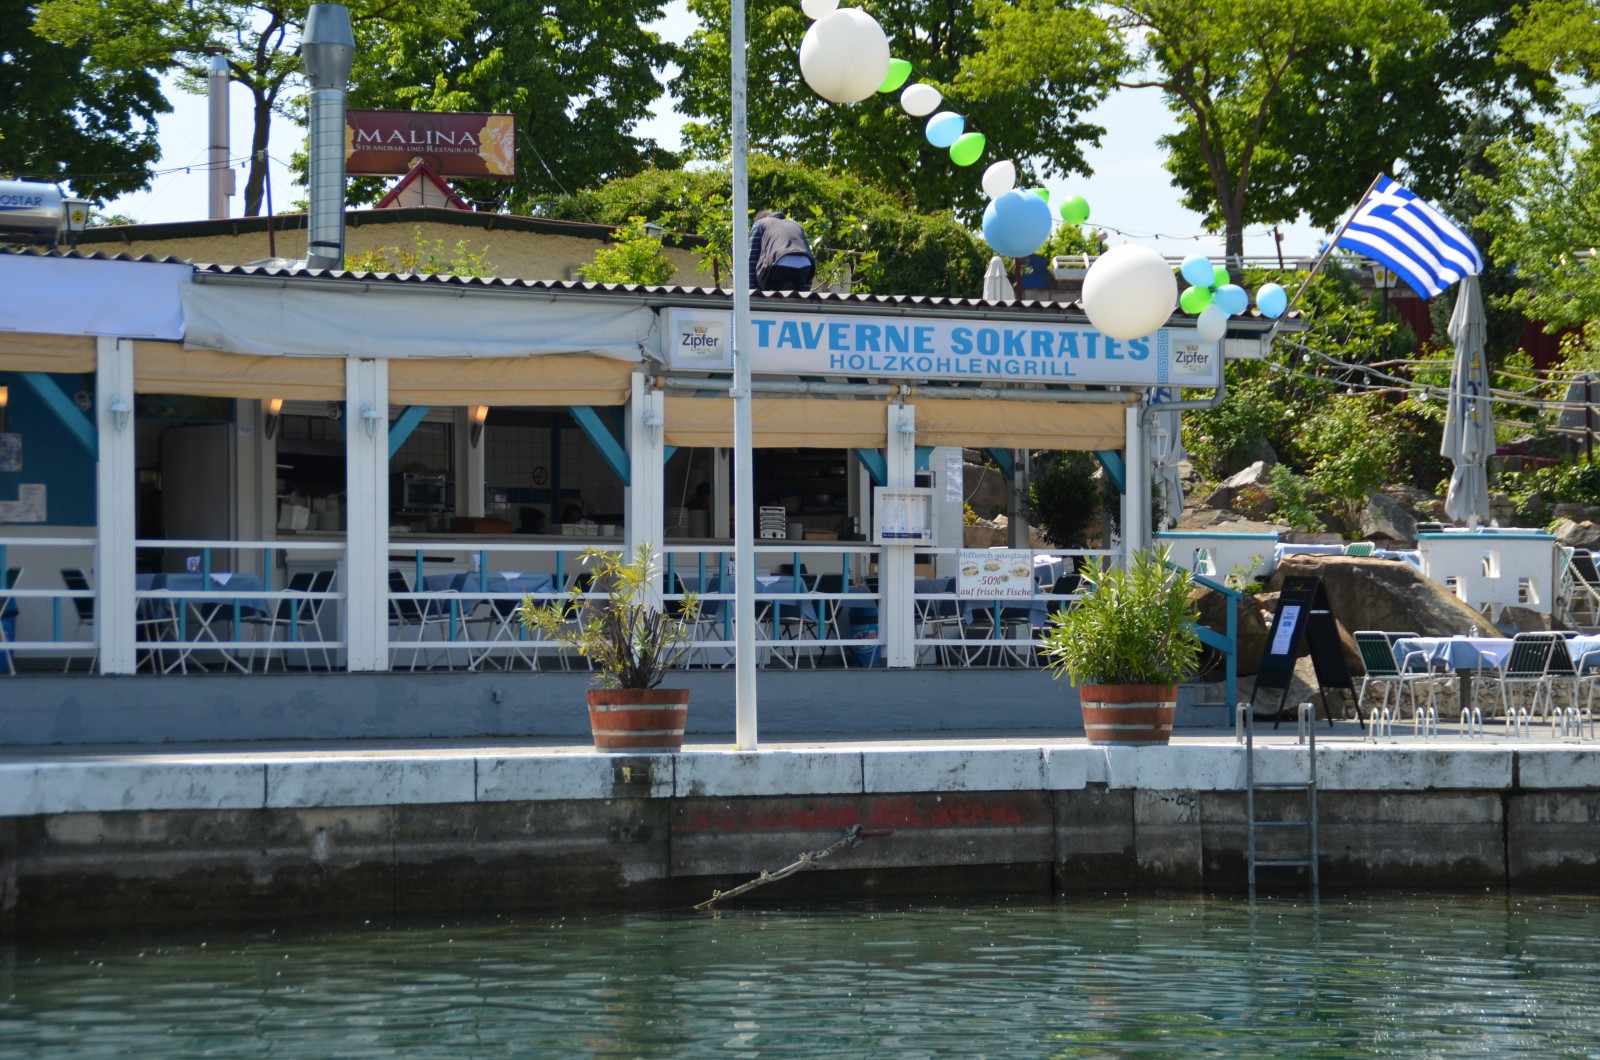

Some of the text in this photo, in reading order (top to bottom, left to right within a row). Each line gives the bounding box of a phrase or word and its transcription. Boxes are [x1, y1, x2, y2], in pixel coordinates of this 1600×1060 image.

[356, 128, 478, 146] MALINA
[355, 143, 404, 152] STRANDBAR
[426, 145, 480, 154] RESTAURANT
[0, 194, 42, 206] OSTAR
[682, 333, 719, 348] Zipfer
[751, 319, 1150, 361] TAVERNE SOKRATES
[830, 353, 1077, 377] HOLZKOHLENGRILL
[1175, 351, 1209, 365] Zipfer
[960, 588, 1031, 597] auf frische Fische
